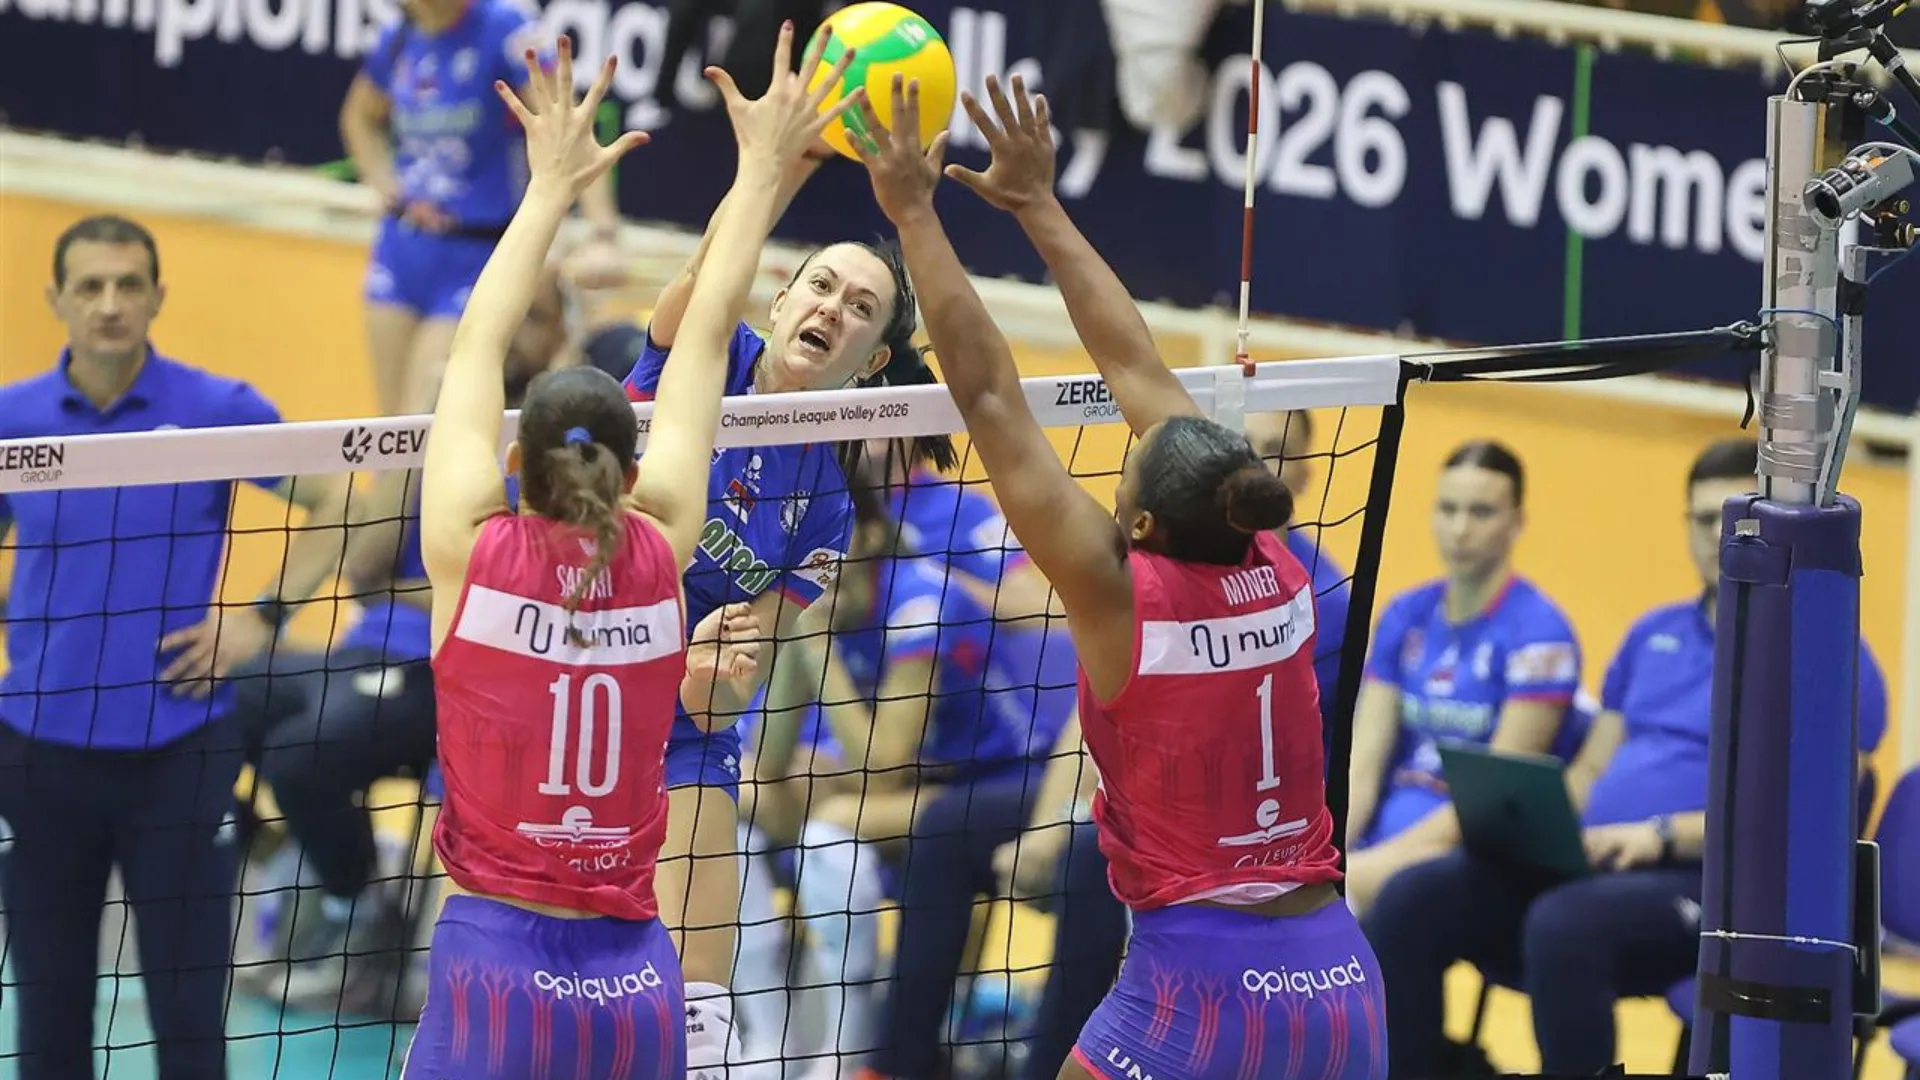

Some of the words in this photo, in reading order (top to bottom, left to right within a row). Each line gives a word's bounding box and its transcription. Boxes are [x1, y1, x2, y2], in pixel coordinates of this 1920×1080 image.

[1436, 81, 1858, 274] Wome
[1056, 380, 1112, 406] ZERE
[721, 413, 789, 429] Champions
[792, 408, 837, 425] League
[839, 404, 876, 422] Volley
[878, 403, 909, 418] 2026
[378, 429, 426, 455] CEV
[21, 469, 63, 483] GROUP
[1220, 565, 1280, 606] MINER
[538, 672, 623, 797] 10
[1255, 672, 1281, 792] 1
